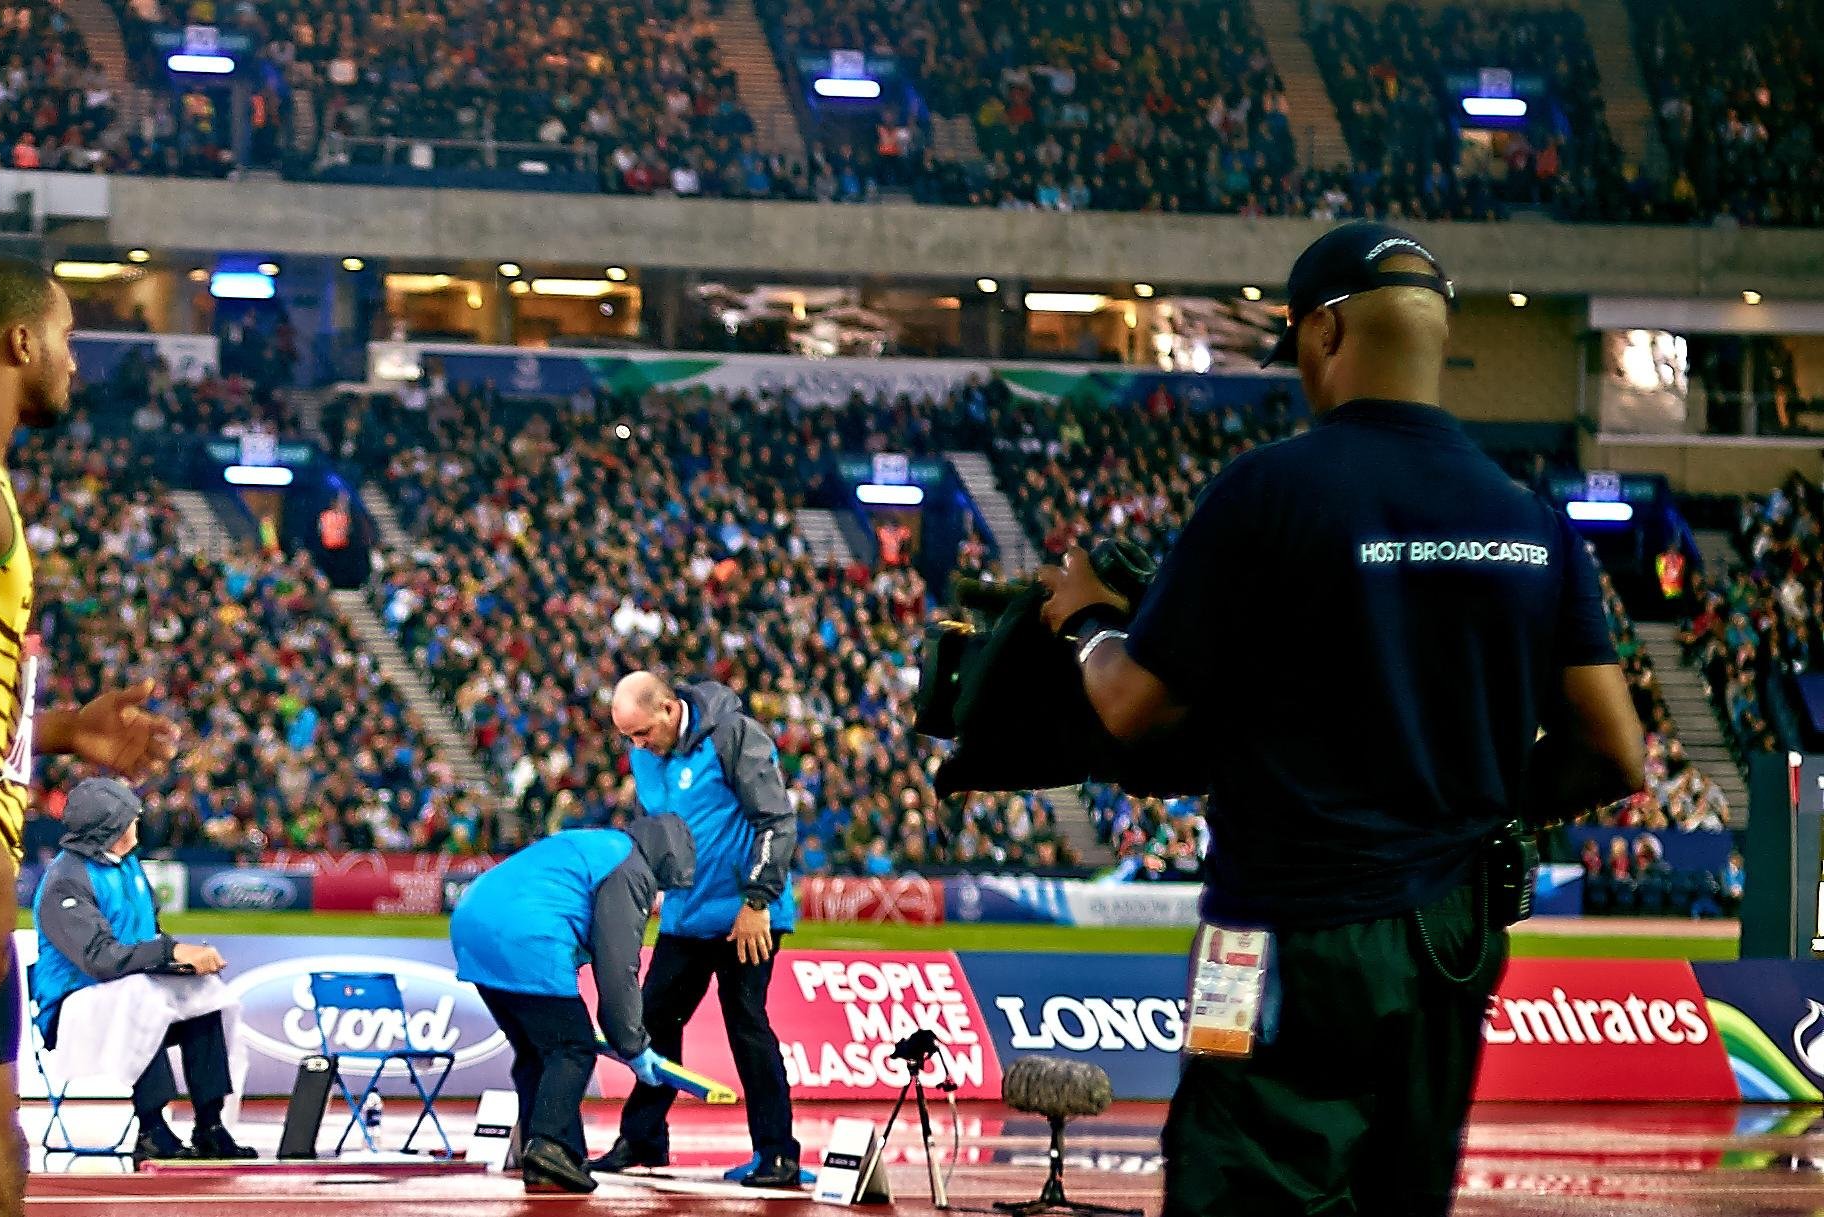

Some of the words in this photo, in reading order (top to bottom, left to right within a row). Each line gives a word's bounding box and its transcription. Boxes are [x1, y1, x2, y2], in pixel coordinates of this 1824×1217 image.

[1360, 542, 1405, 562] HOST
[1410, 541, 1549, 566] BROADCASTER
[791, 960, 963, 1003] PEOPLE
[282, 975, 461, 1051] Ford
[845, 1002, 979, 1046] MAKE
[995, 995, 1186, 1052] LONG
[1484, 986, 1710, 1045] Emirates
